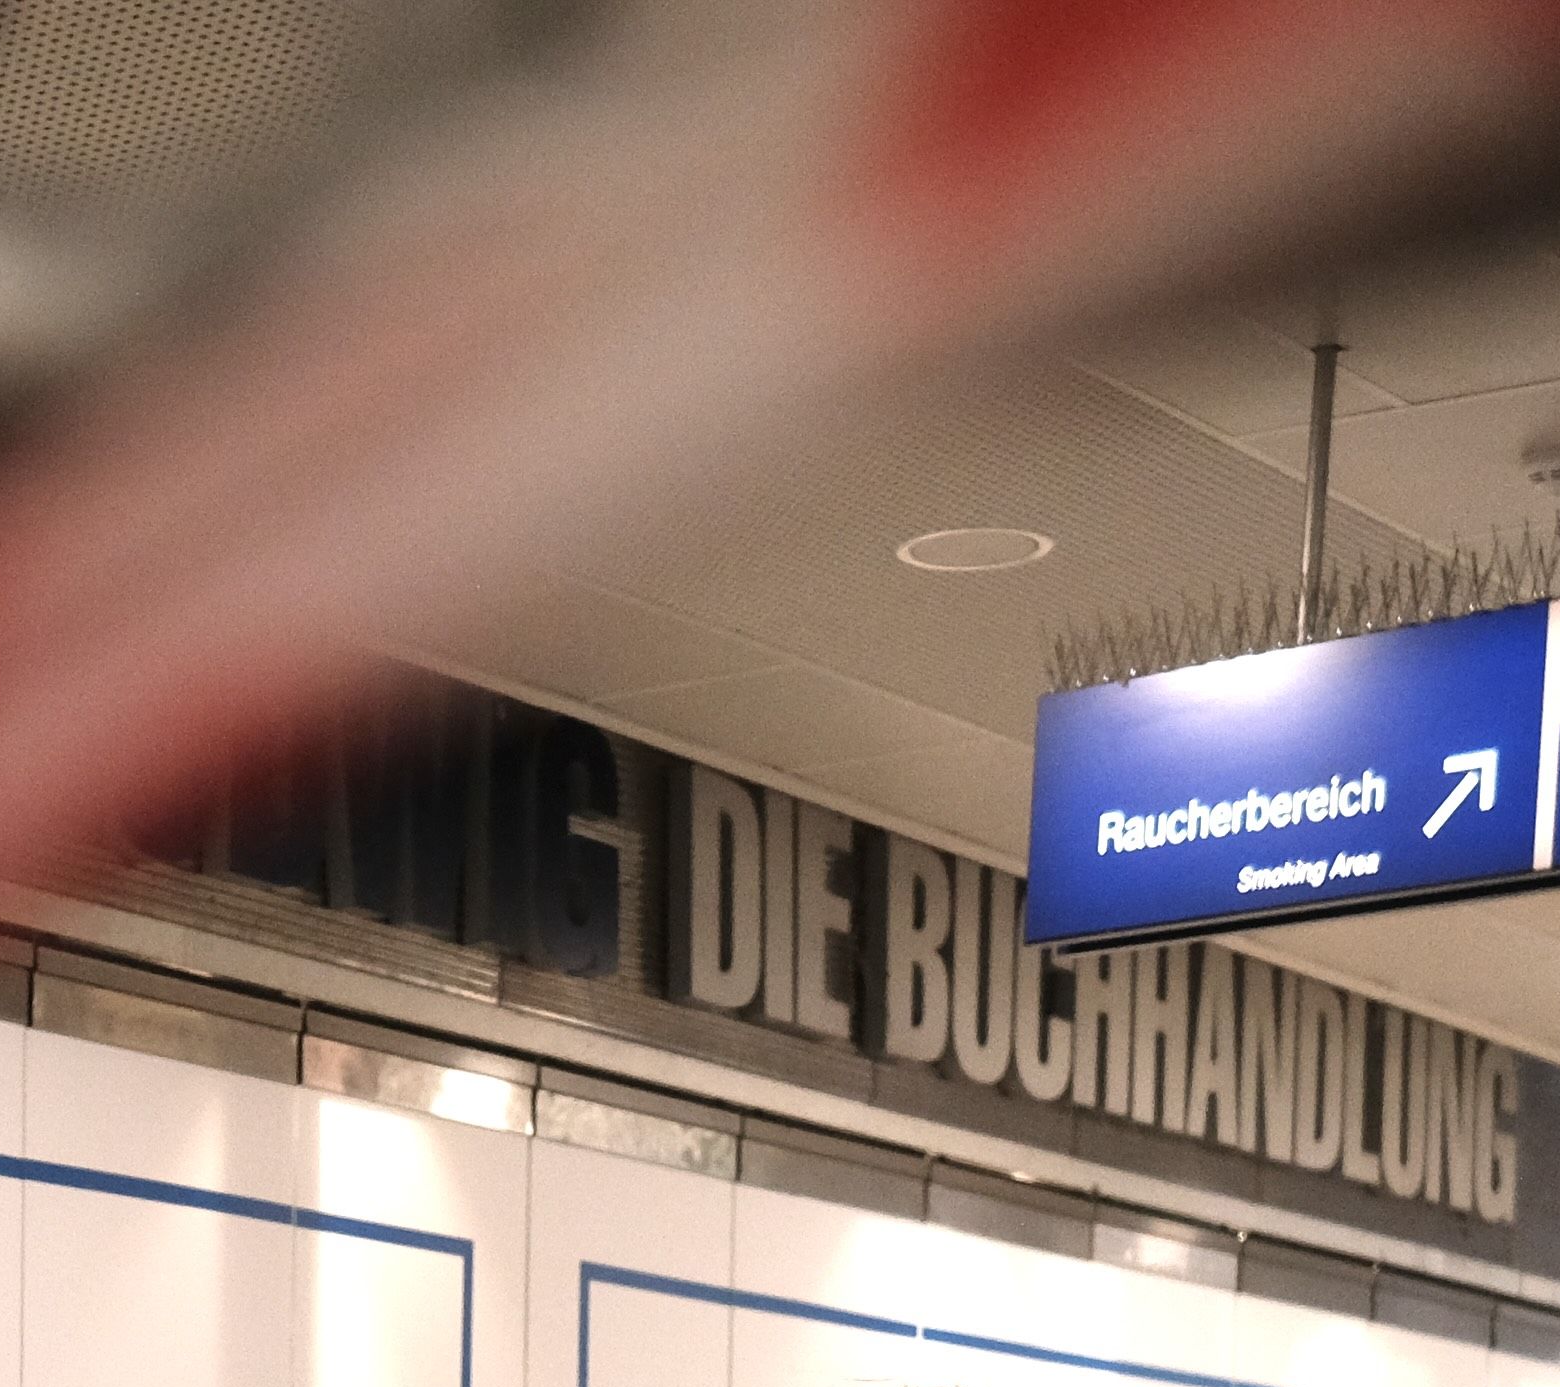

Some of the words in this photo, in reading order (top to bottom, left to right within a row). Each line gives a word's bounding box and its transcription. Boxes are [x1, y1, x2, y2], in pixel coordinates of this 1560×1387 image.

[1097, 767, 1386, 855] Raucherbereich
[1236, 859, 1328, 893] Smoking
[1329, 850, 1380, 880] Area
[691, 758, 853, 1041] DIE
[886, 828, 1518, 1224] BUCHHANDLUNG
